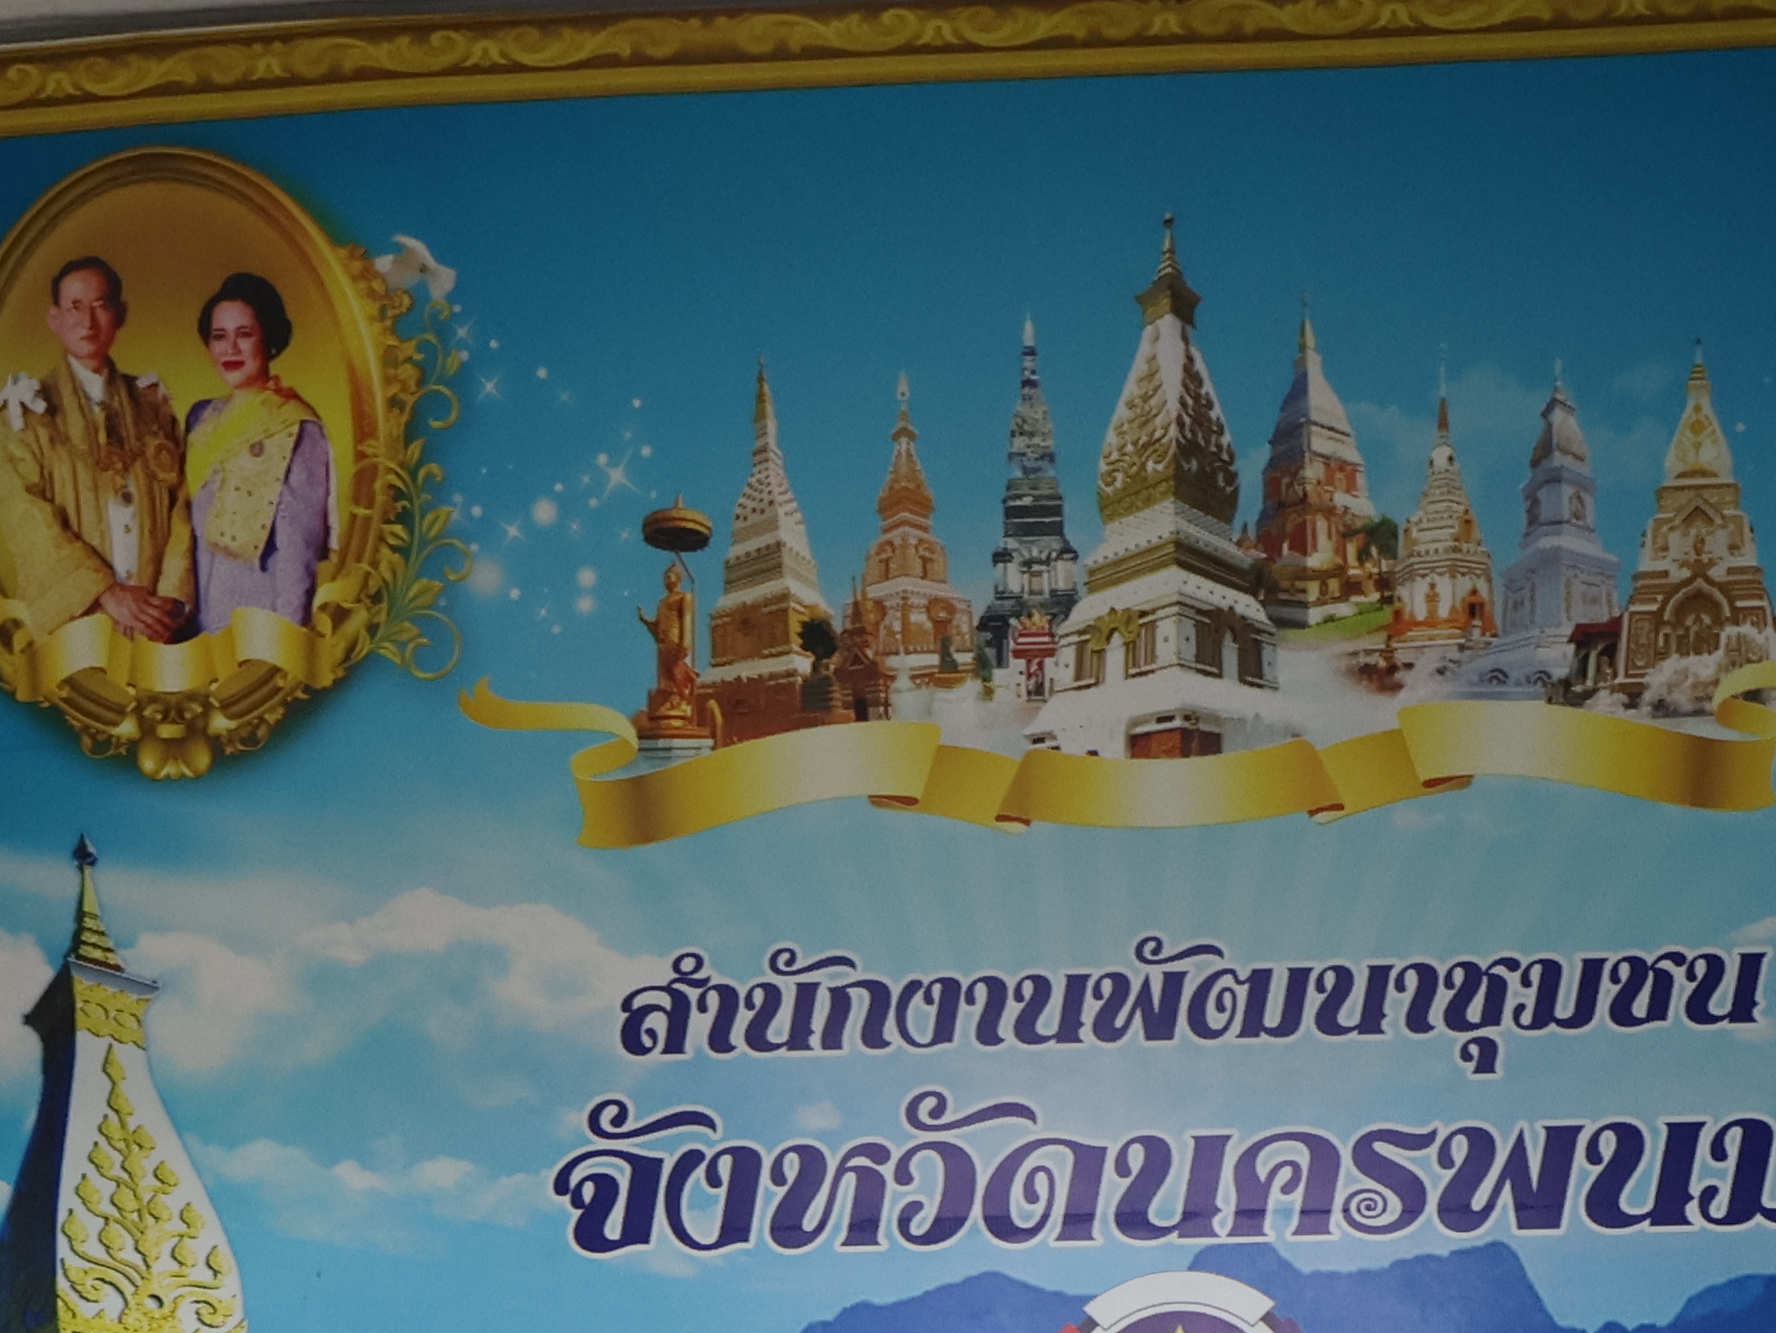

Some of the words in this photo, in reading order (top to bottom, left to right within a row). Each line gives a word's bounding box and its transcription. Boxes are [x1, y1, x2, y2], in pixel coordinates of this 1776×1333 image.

[618, 936, 1771, 1076] สำนักงานพัฒนาชุมชน
